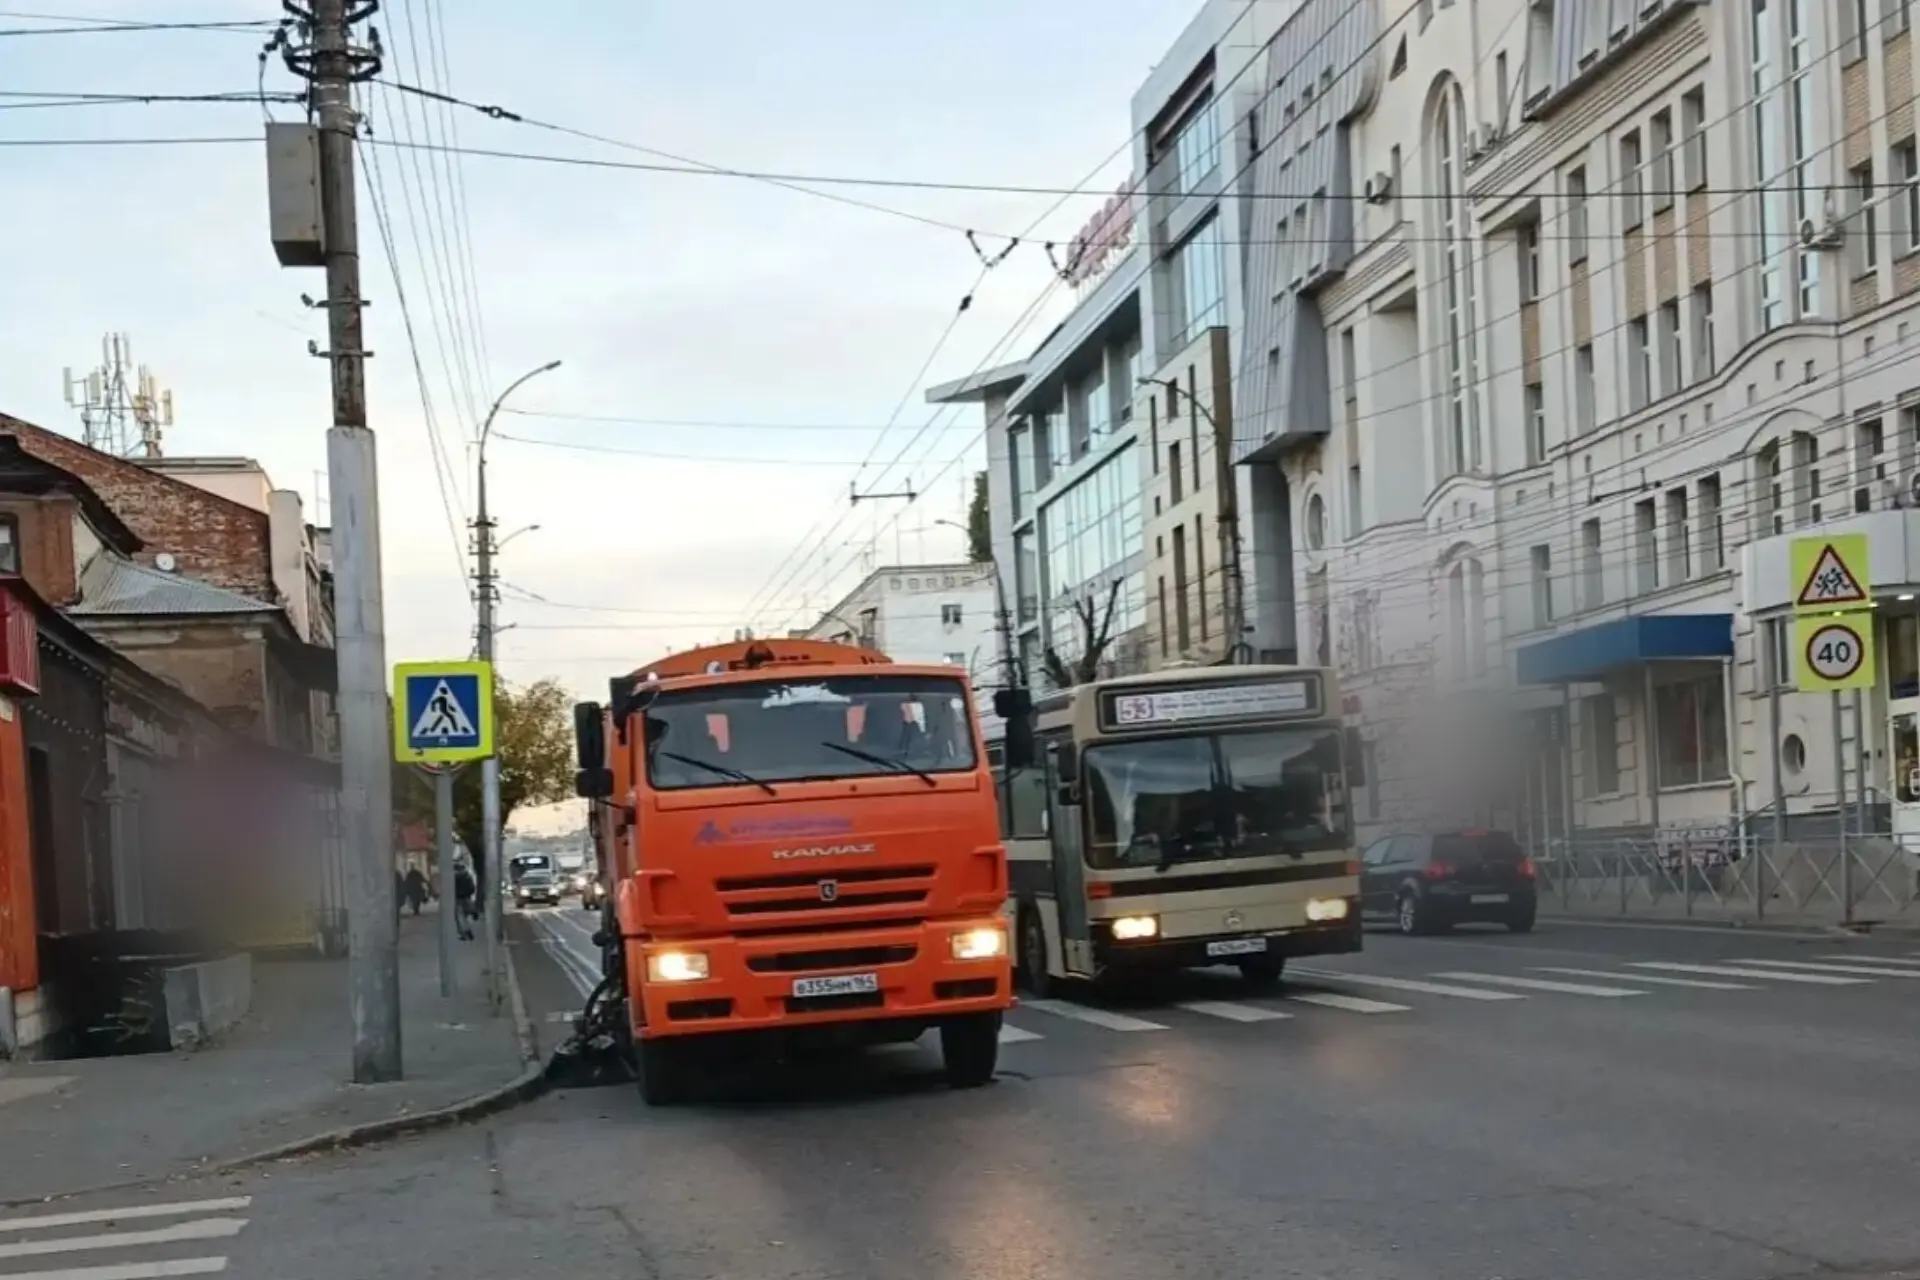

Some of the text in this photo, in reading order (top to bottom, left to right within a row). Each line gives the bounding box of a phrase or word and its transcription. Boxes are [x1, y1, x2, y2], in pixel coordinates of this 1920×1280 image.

[1817, 641, 1851, 664] 40
[1121, 697, 1152, 720] 53
[772, 843, 876, 859] KAMAZ
